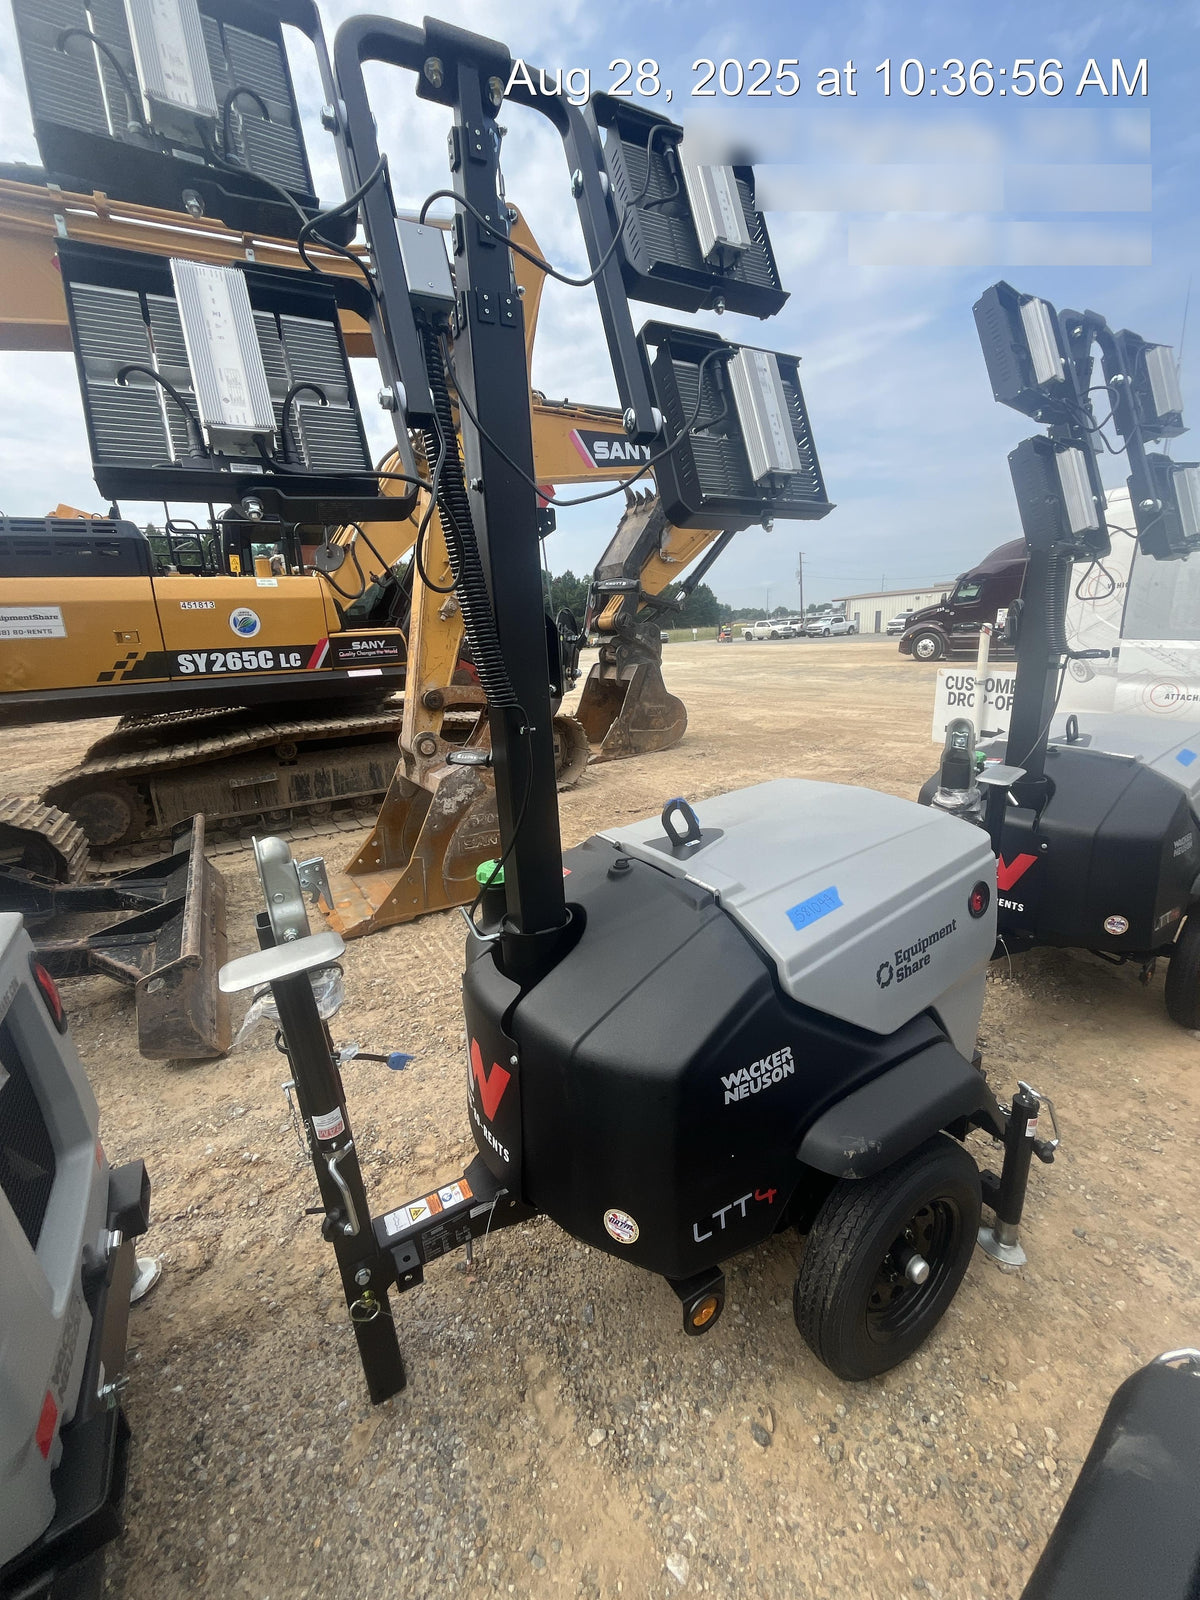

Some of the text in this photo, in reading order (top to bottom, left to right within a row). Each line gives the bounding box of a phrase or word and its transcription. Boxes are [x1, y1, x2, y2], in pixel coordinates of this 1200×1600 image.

[593, 441, 651, 460] SANY
[181, 601, 216, 609] 451813
[0, 614, 59, 623] ipmentShare
[351, 640, 386, 650] SANY
[177, 650, 302, 674] SY265C LC
[996, 898, 1025, 912] ENTS
[894, 918, 957, 966] Equipment
[896, 954, 931, 983] Share
[720, 1046, 793, 1089] WACKER
[725, 1060, 795, 1105] NEUSON
[693, 1188, 777, 1243] LTT4
